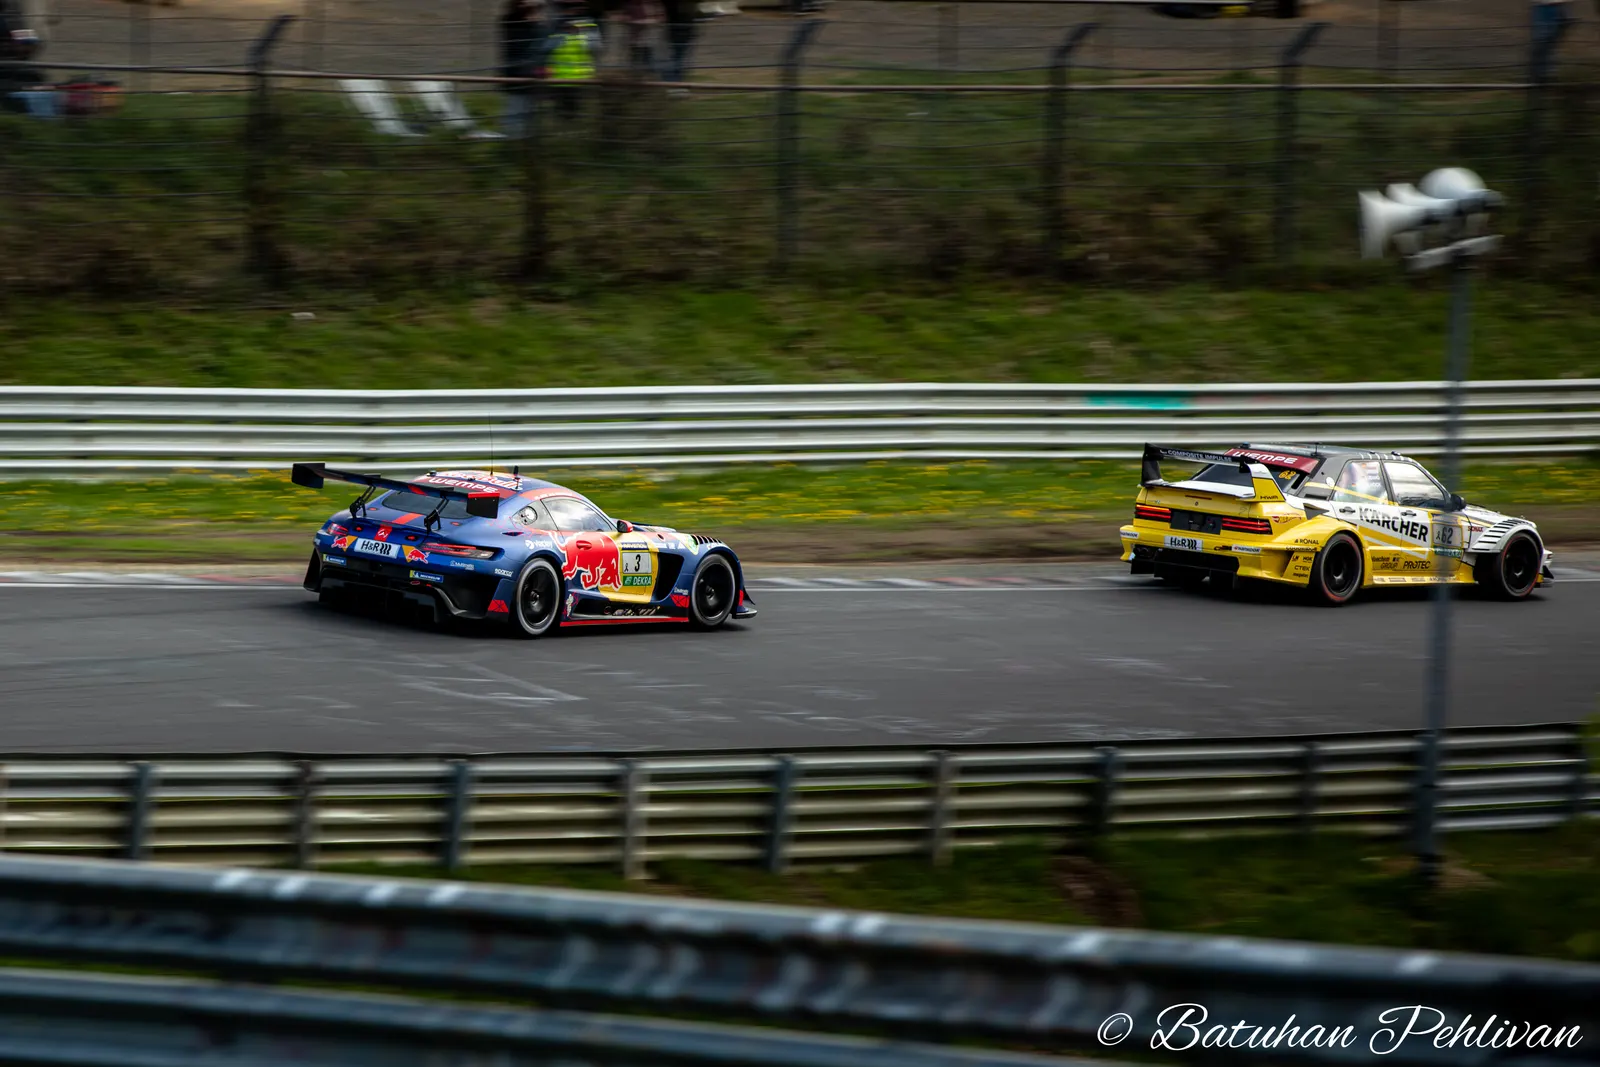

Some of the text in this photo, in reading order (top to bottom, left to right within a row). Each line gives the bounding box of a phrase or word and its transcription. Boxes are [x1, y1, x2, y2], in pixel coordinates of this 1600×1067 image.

[1278, 470, 1297, 480] 62
[1441, 526, 1454, 544] 62
[634, 554, 641, 572] 3
[632, 576, 652, 586] DEKRA
